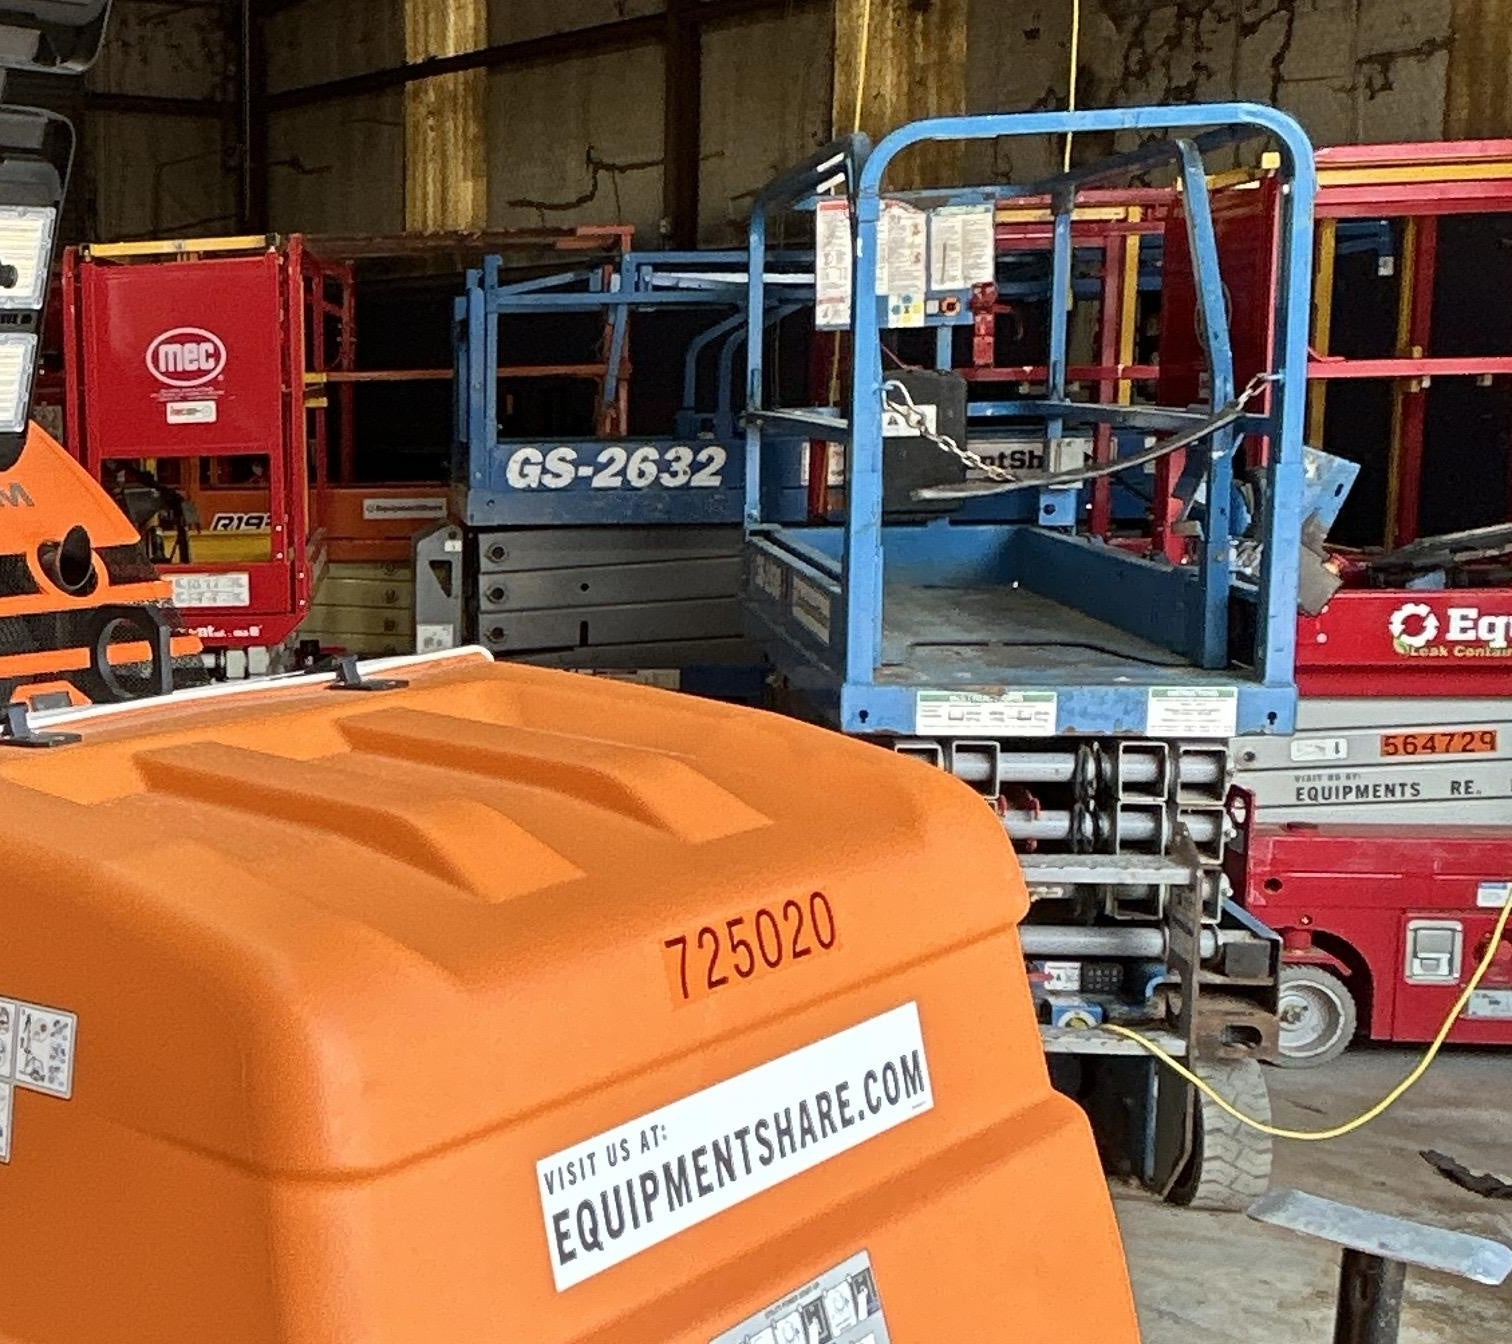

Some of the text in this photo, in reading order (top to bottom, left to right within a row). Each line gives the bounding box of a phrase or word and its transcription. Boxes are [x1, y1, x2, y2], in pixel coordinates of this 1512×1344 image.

[506, 446, 728, 489] GS-2632
[211, 514, 271, 532] R19
[1381, 732, 1496, 756] 564729
[664, 891, 837, 1000] 725020
[544, 1124, 668, 1196] VISIT US AT:
[553, 1049, 926, 1266] EQUIPMENTSHARE.COM
